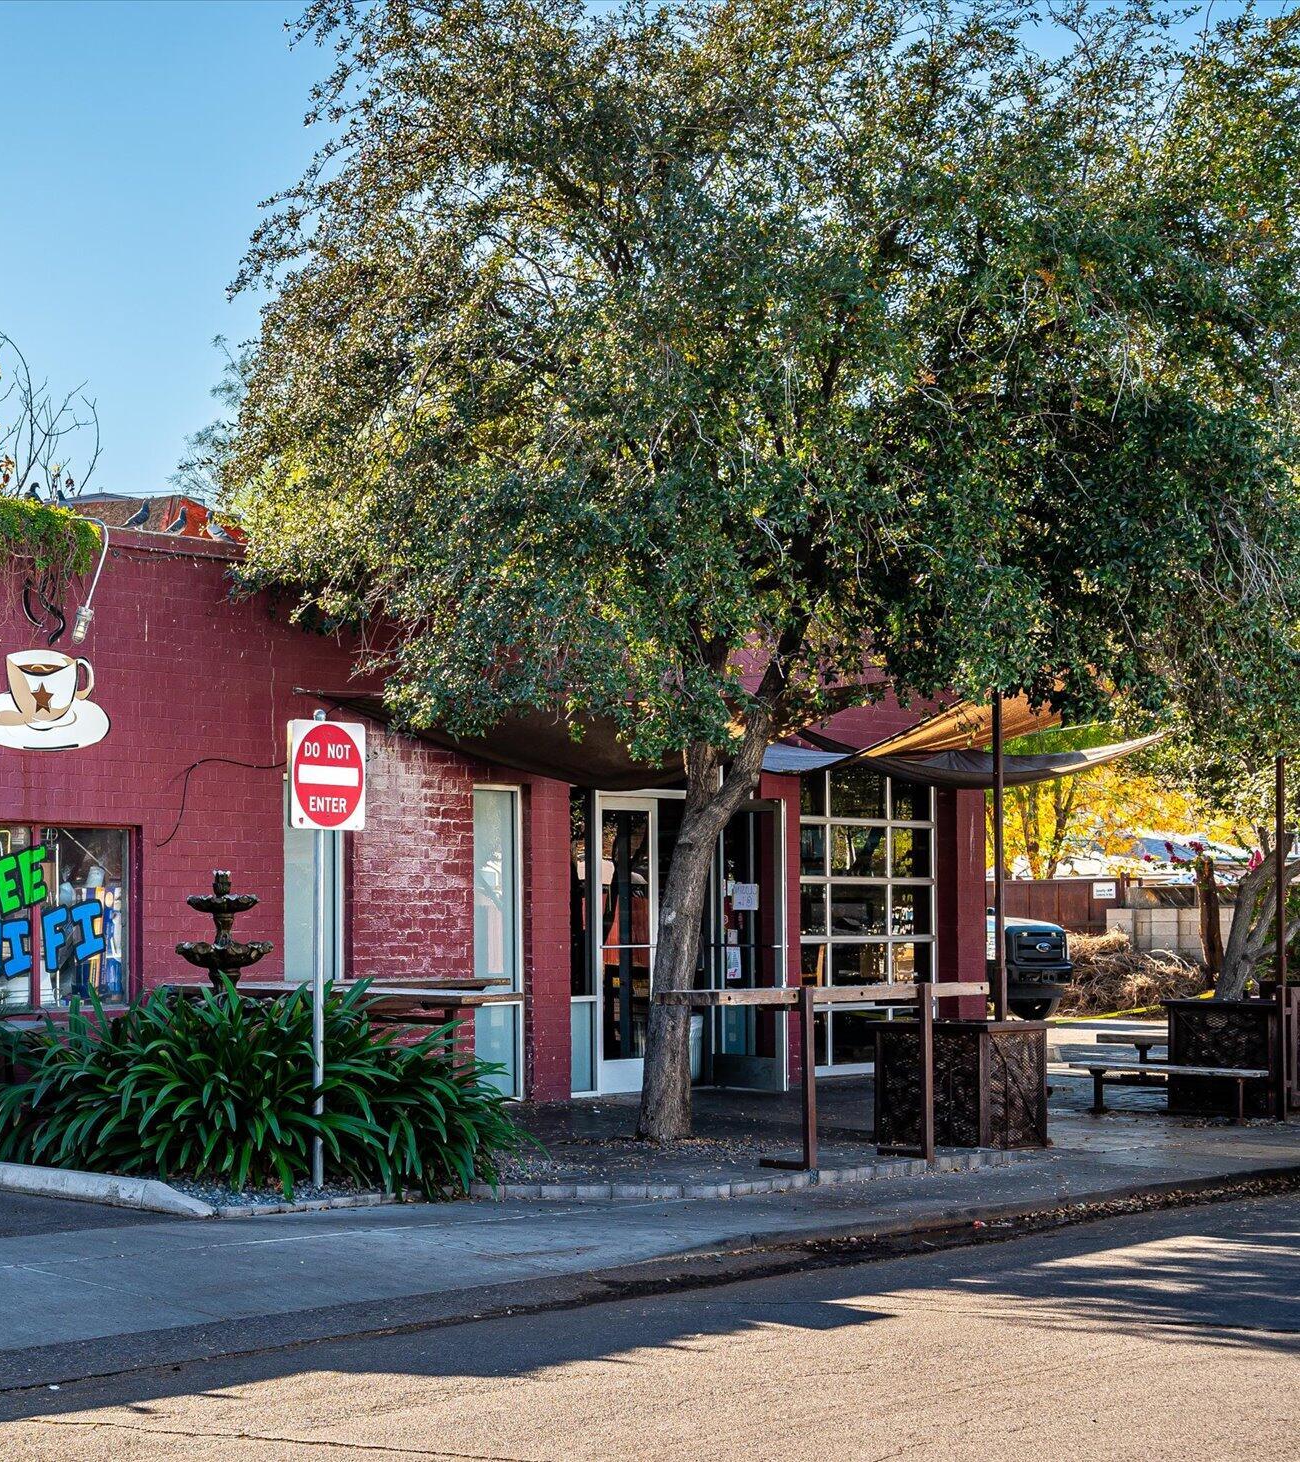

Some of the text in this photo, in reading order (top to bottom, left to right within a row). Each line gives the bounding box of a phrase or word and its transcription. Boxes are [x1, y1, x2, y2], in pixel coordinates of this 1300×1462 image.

[304, 741, 351, 760] DO NOT
[309, 795, 347, 813] ENTER
